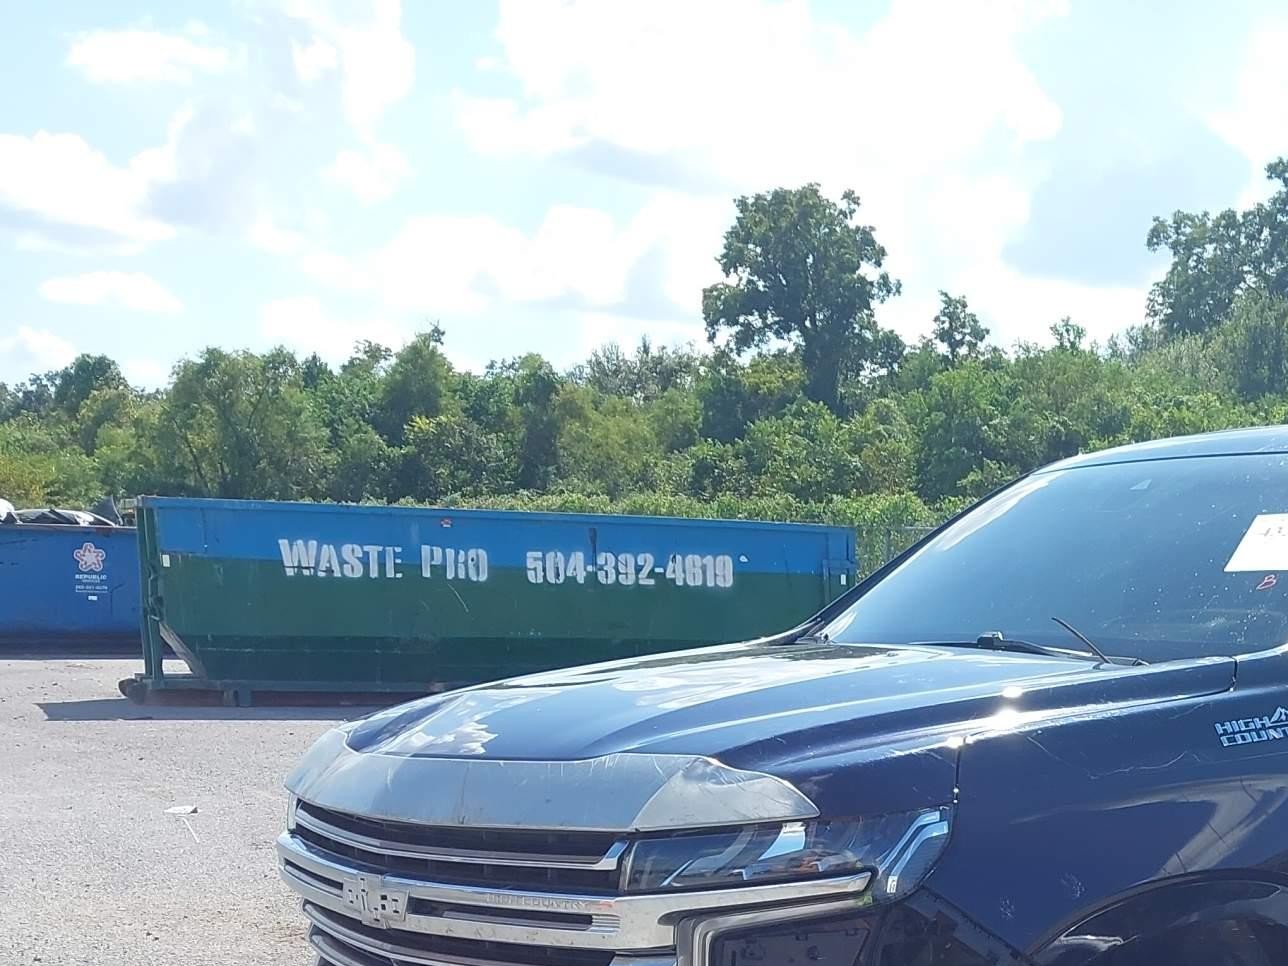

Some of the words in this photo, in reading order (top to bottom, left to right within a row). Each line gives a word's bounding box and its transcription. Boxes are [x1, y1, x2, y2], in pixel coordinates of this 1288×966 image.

[278, 538, 403, 578] WASTE
[421, 544, 489, 582] PRO
[1214, 716, 1272, 735] HIGH
